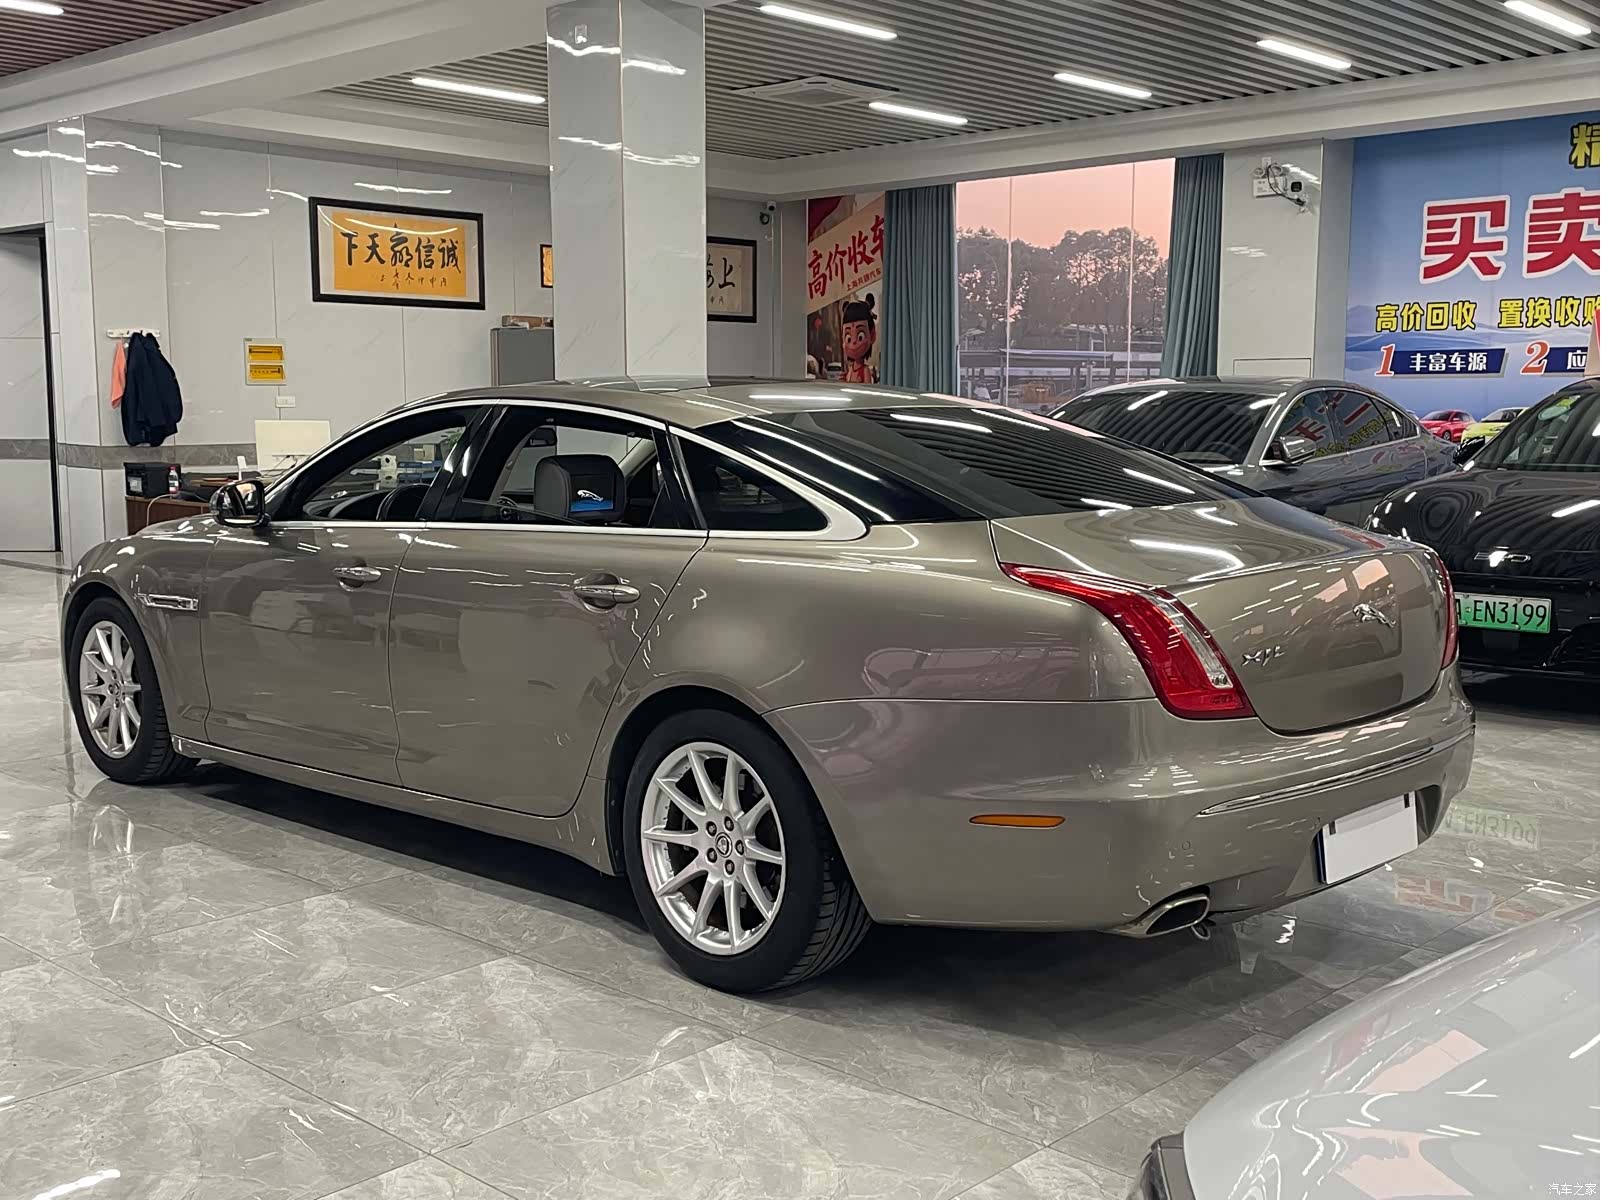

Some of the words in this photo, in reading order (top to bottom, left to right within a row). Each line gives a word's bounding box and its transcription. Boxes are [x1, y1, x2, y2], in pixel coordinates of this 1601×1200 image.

[1421, 190, 1601, 281] 买卖
[1376, 300, 1477, 332] 高价回收
[1375, 344, 1395, 376] 1
[1409, 352, 1488, 372] 丰富车源
[1520, 340, 1549, 375] 2
